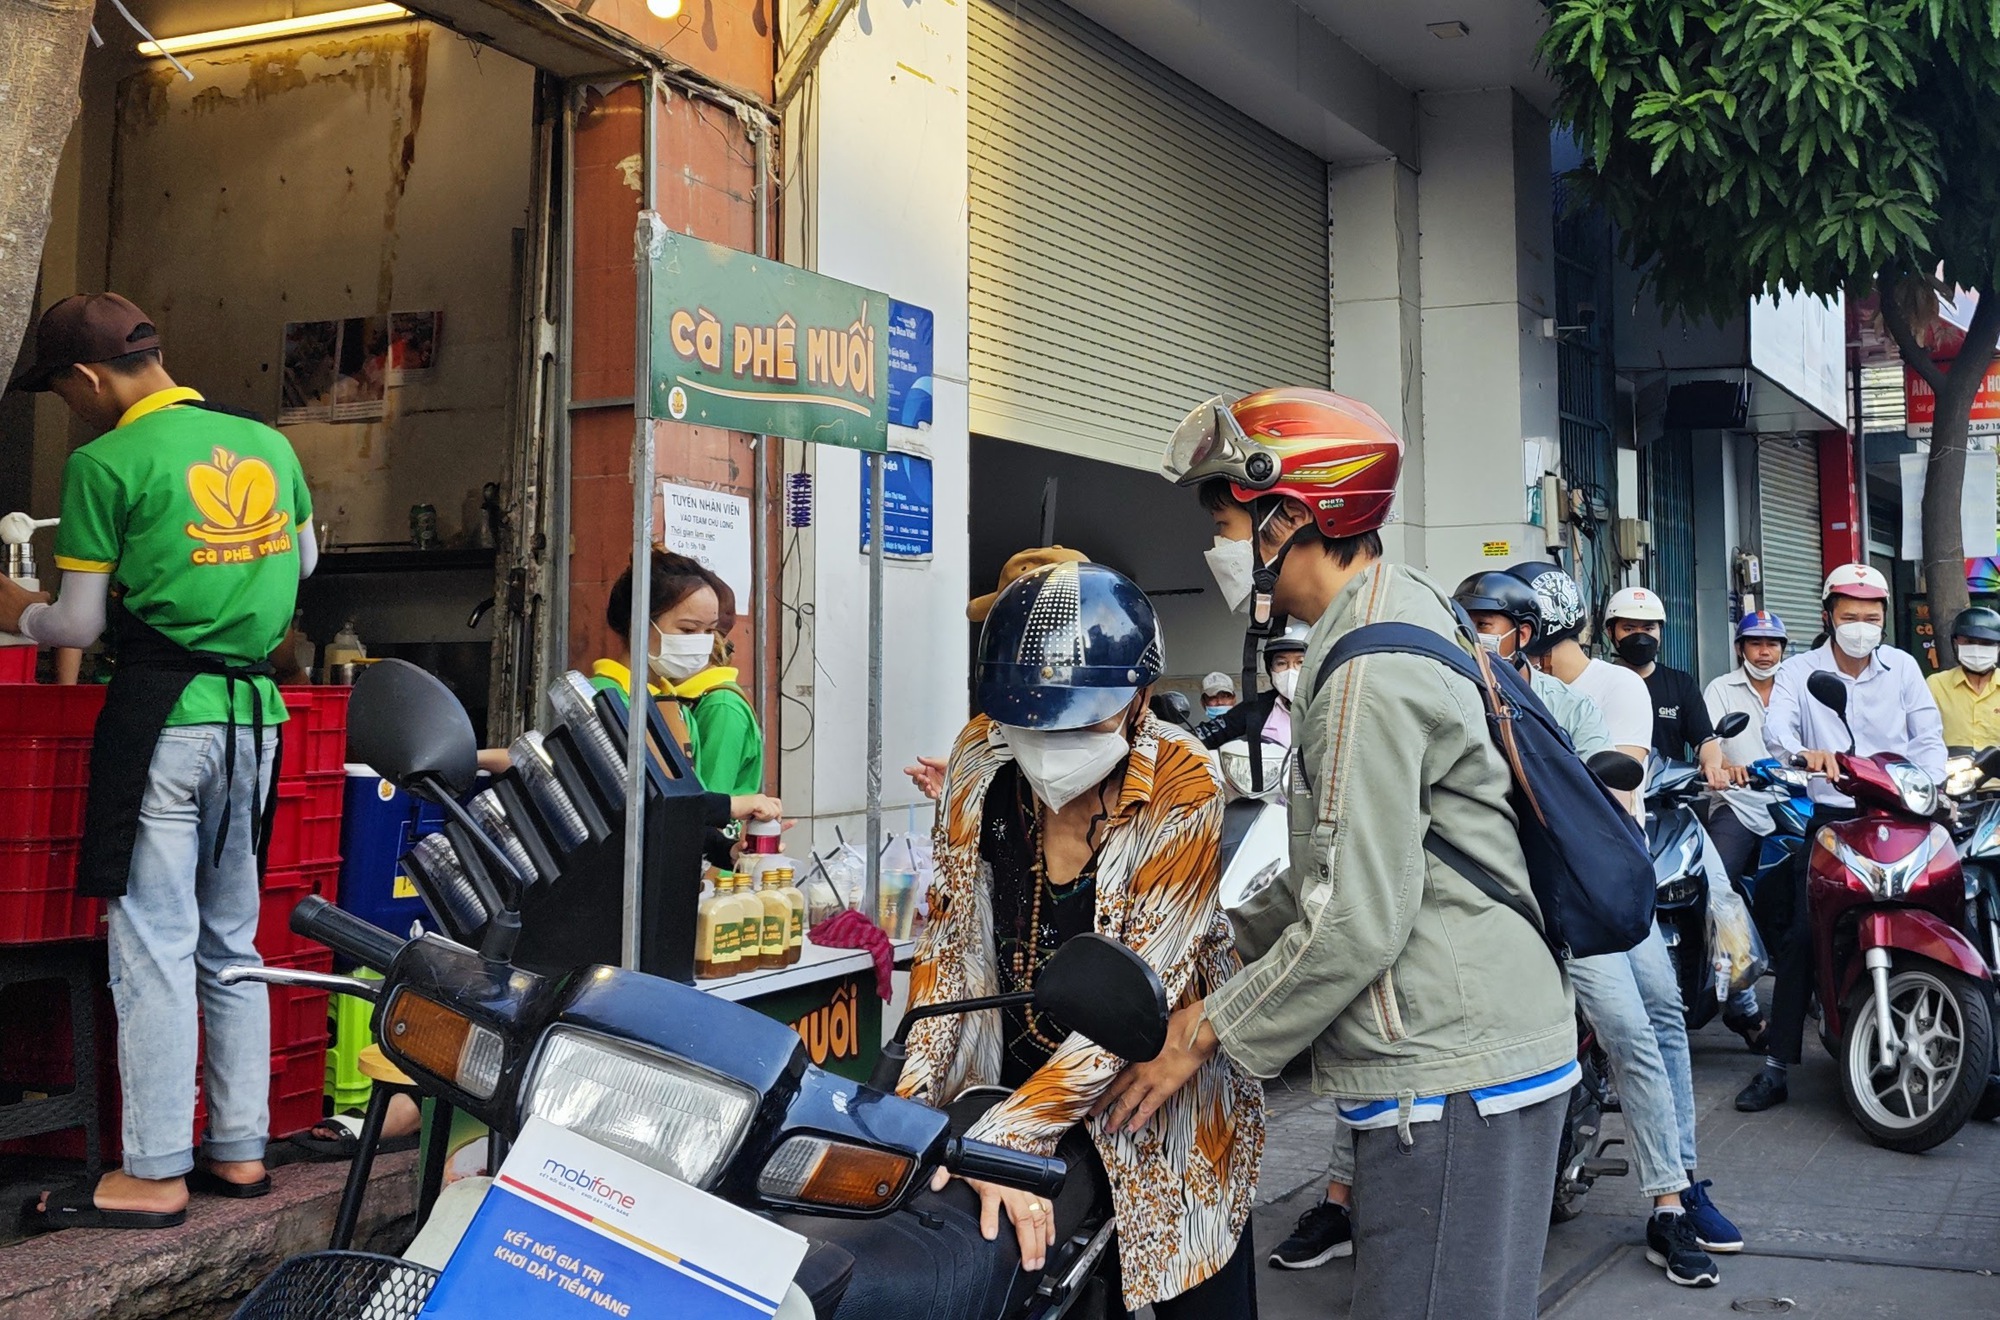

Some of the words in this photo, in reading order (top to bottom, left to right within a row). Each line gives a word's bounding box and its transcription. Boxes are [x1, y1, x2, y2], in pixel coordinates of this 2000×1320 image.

[734, 313, 797, 380] PHÊ
[1976, 423, 1989, 431] 867
[693, 515, 707, 526] TEAM
[720, 520, 734, 530] LONG
[223, 545, 253, 562] PHÊ
[543, 1159, 635, 1209] mobifone
[503, 1229, 533, 1250] KẾT
[531, 1242, 557, 1262] NỐI
[556, 1254, 581, 1274] GIÁ
[526, 1260, 558, 1282] DẬY
[590, 1293, 631, 1318] NĂNG
